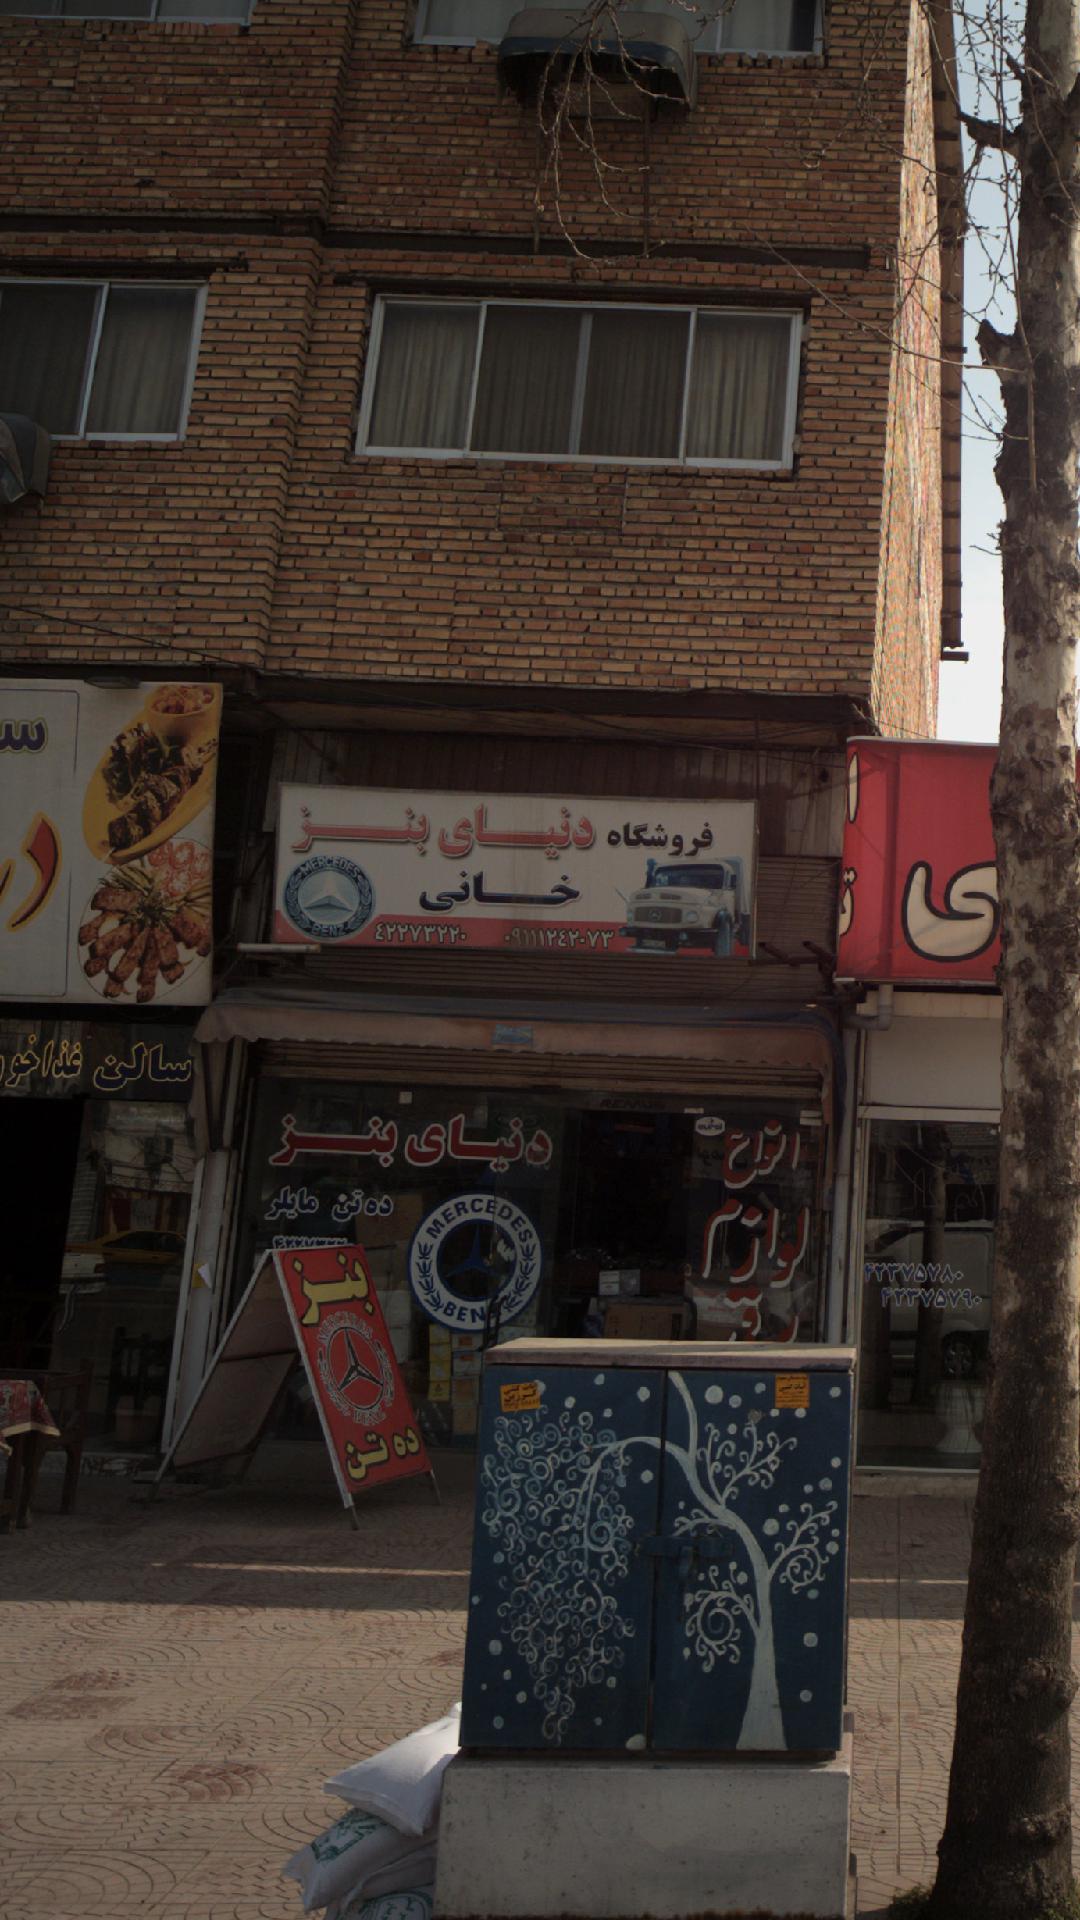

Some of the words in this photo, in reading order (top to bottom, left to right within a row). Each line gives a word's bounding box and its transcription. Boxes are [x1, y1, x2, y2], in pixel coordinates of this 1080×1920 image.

[291, 805, 430, 856] بنز
[438, 803, 595, 859] دنیای
[607, 822, 713, 856] فروشگاه
[300, 855, 361, 879] MERCEDES
[419, 870, 581, 912] خانی
[311, 922, 347, 938] BENZ
[0, 1033, 82, 1088] غذاخور
[93, 1041, 192, 1092] سالن
[269, 1114, 398, 1167] بنز
[405, 1114, 552, 1171] دنیای
[331, 1189, 363, 1223] تن
[365, 1194, 394, 1216] ده
[426, 1198, 533, 1243] MERCEDES
[293, 1251, 375, 1327] بنز
[346, 1431, 389, 1480] تن
[393, 1427, 420, 1457] ده
